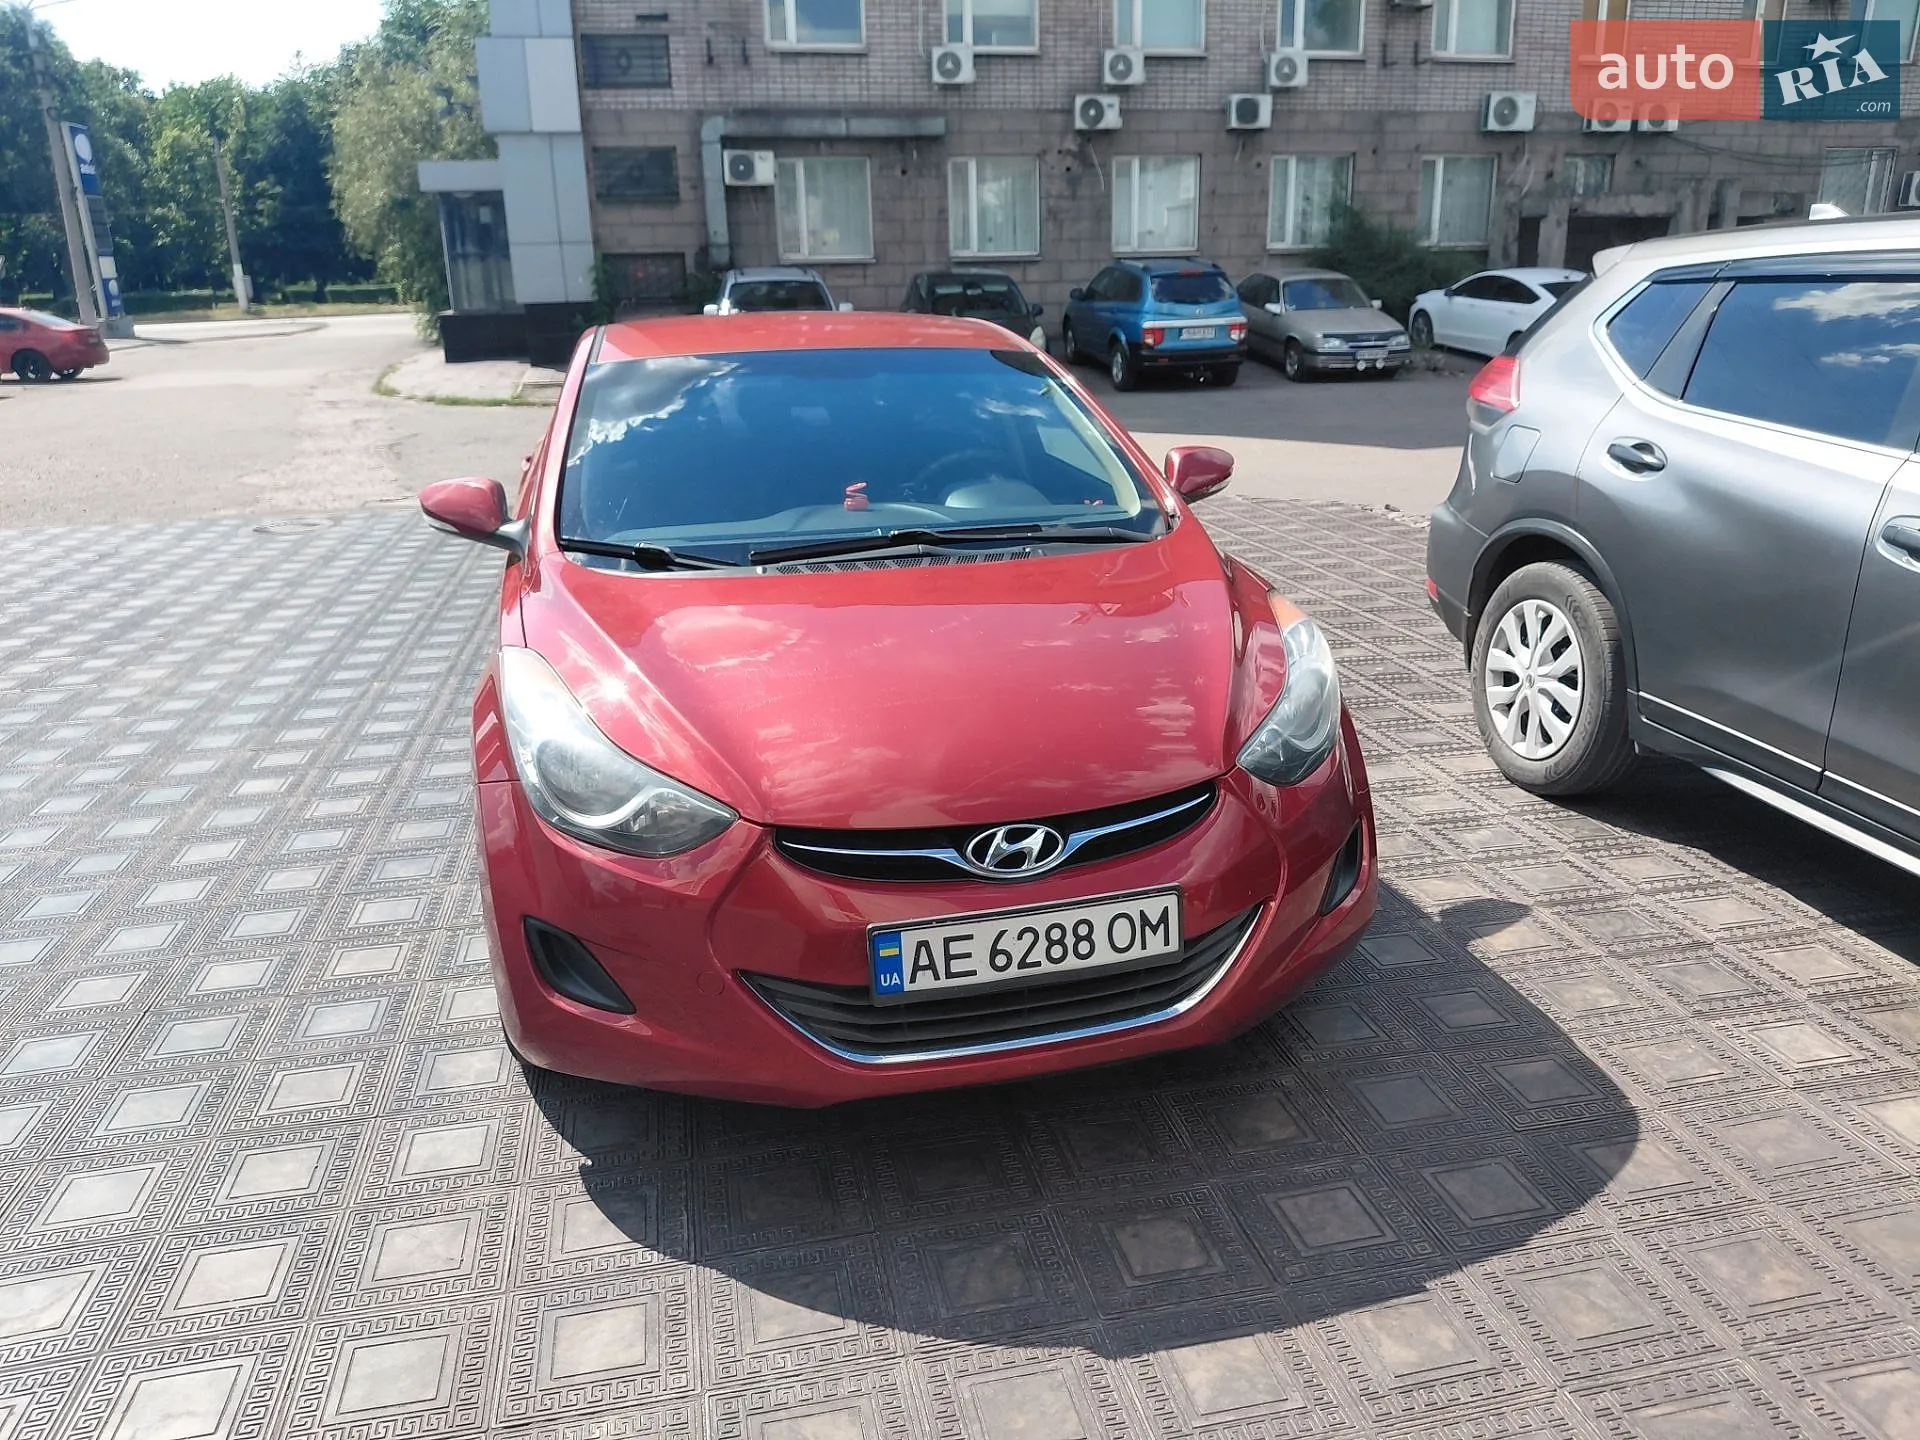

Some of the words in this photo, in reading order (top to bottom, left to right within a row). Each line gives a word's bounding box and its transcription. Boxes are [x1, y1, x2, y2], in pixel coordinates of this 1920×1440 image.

[908, 933, 977, 984] AE
[988, 918, 1096, 973] 6288
[1108, 905, 1171, 954] OM
[880, 973, 901, 987] UA
